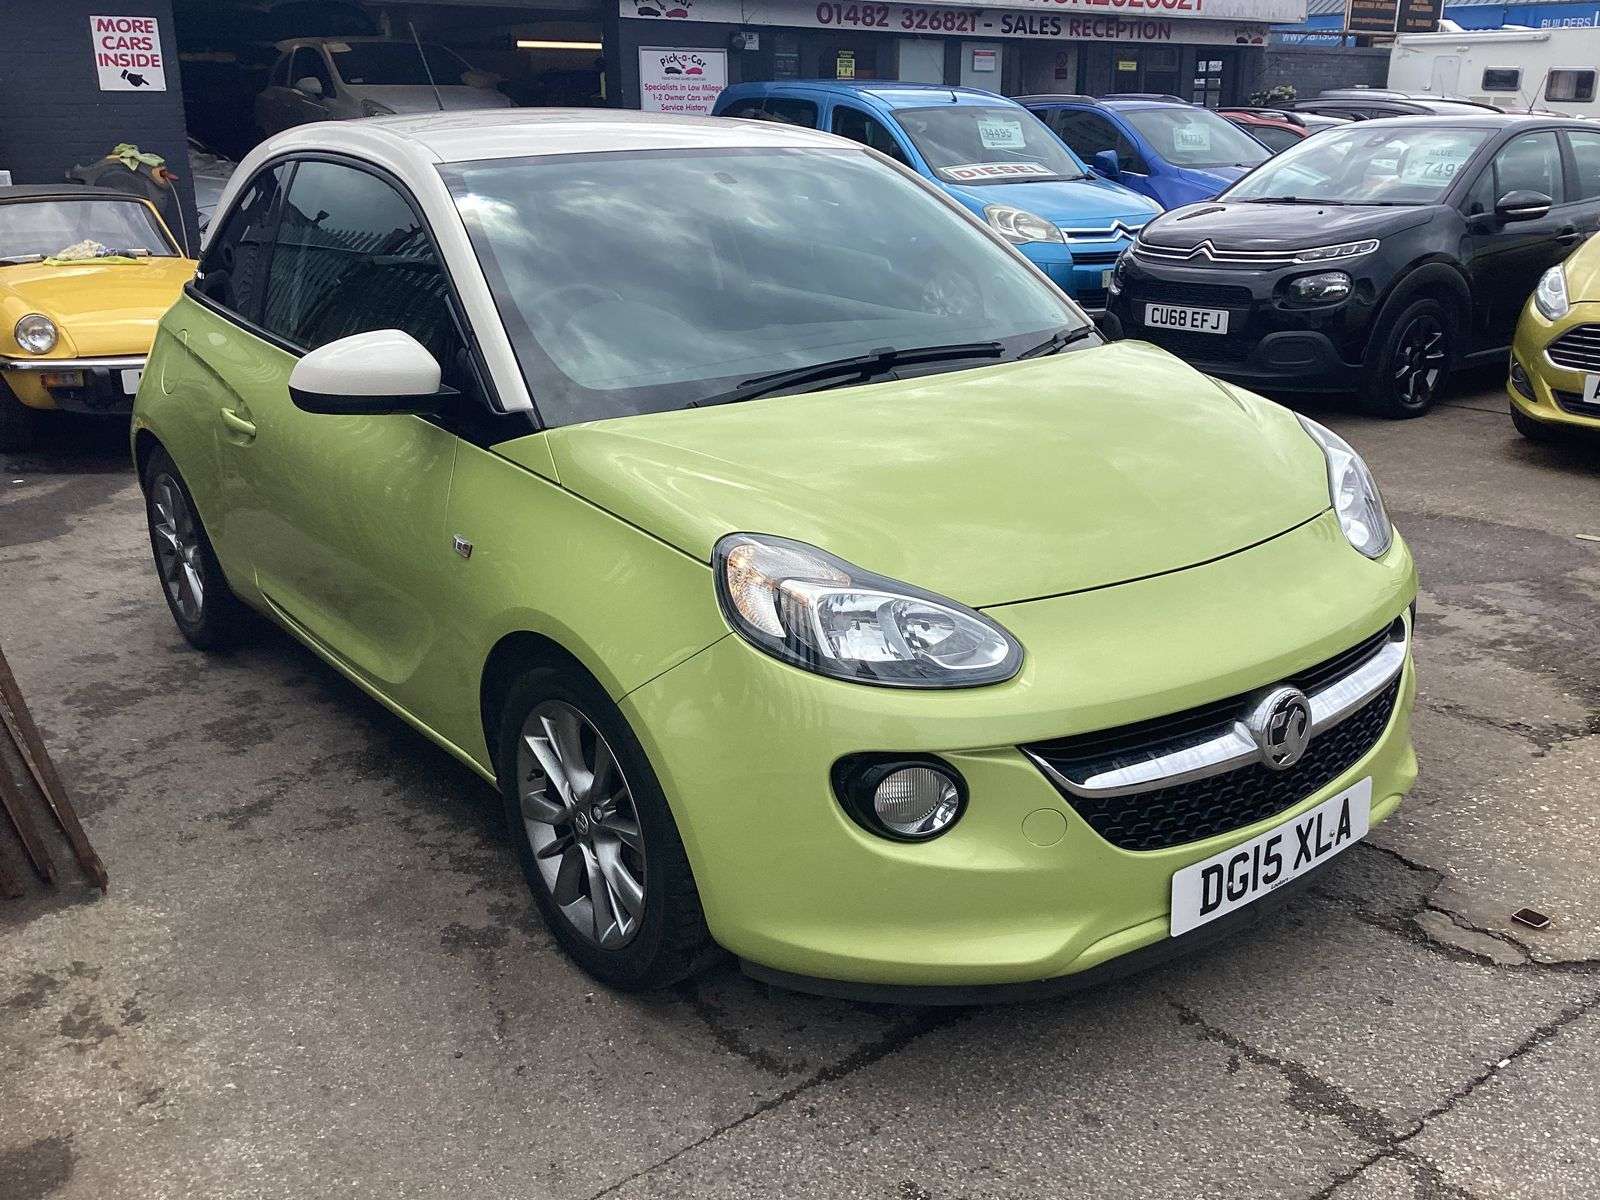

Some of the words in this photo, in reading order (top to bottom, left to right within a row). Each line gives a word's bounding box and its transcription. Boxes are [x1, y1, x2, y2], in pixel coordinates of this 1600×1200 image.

[97, 18, 154, 33] MORE
[816, 2, 889, 27] 01482
[901, 8, 976, 32] 326821
[1001, 14, 1061, 36] SALES
[1069, 17, 1171, 40] RECEPTION
[102, 36, 153, 50] CARS
[98, 53, 160, 67] INSIDE
[660, 53, 706, 67] Pick-a-Car
[644, 83, 678, 92] Specialists
[653, 93, 662, 101] 1-2
[664, 93, 686, 101] Owner
[687, 93, 700, 101] Cars
[661, 103, 684, 111] Service
[686, 103, 707, 112] History
[952, 165, 1048, 178] DIESEL
[1151, 307, 1187, 326] CU68
[1190, 311, 1220, 330] EFJ
[1200, 834, 1283, 917] DG15
[1293, 797, 1351, 871] XLA
